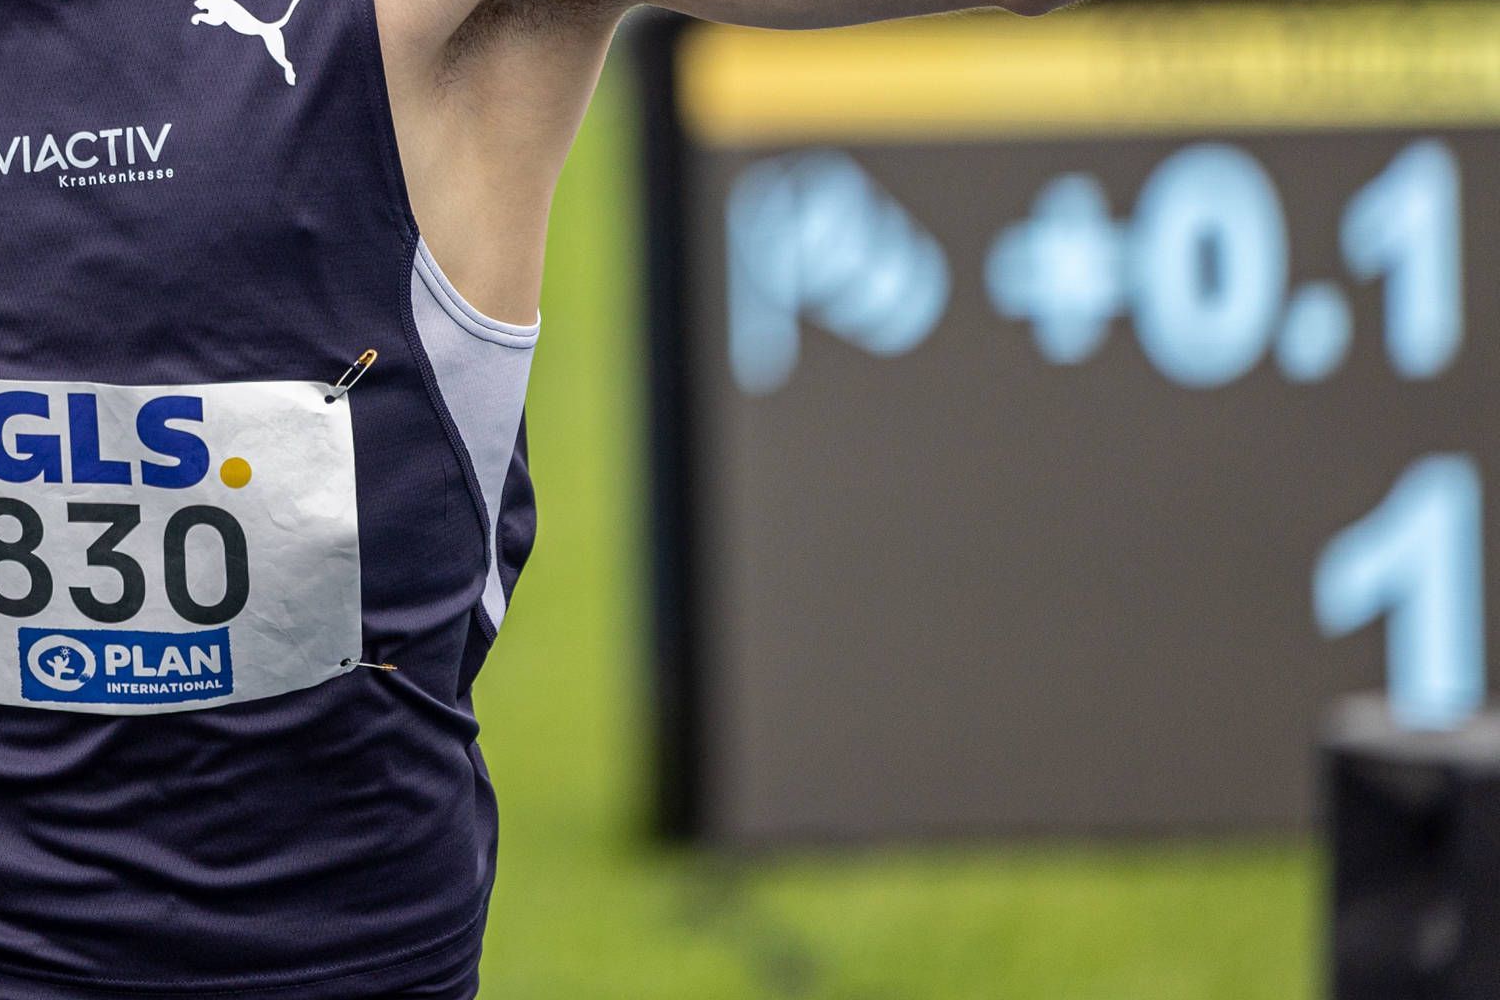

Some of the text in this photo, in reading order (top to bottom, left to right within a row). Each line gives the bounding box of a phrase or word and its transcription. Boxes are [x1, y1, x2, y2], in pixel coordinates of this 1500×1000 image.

[58, 167, 175, 188] Krankenkasse
[984, 139, 1467, 388] +0.1
[1312, 450, 1490, 731] 1
[104, 643, 222, 679] PLAN
[106, 678, 224, 695] INTERNATIONAL
